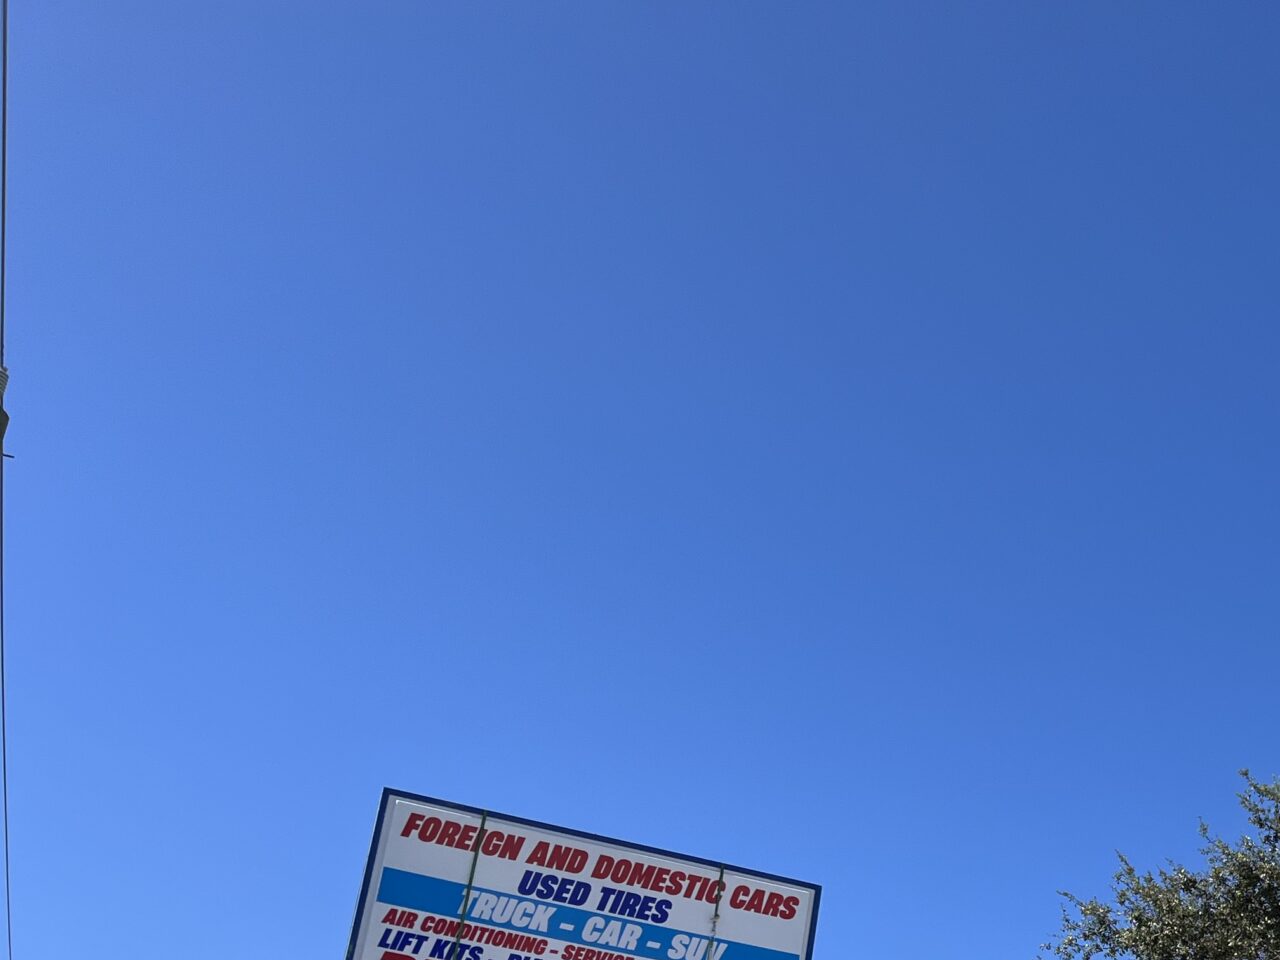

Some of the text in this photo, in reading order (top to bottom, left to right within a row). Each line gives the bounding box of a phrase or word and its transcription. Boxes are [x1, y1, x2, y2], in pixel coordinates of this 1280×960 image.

[401, 812, 800, 920] FOREIGN AND DOMESTIC CARS
[456, 888, 558, 932] TRUCK
[581, 916, 642, 950] CAR
[517, 870, 672, 924] USED TIRES
[377, 928, 429, 954] LIFT
[381, 908, 419, 929] AIR
[420, 915, 548, 955] CONDITIONING
